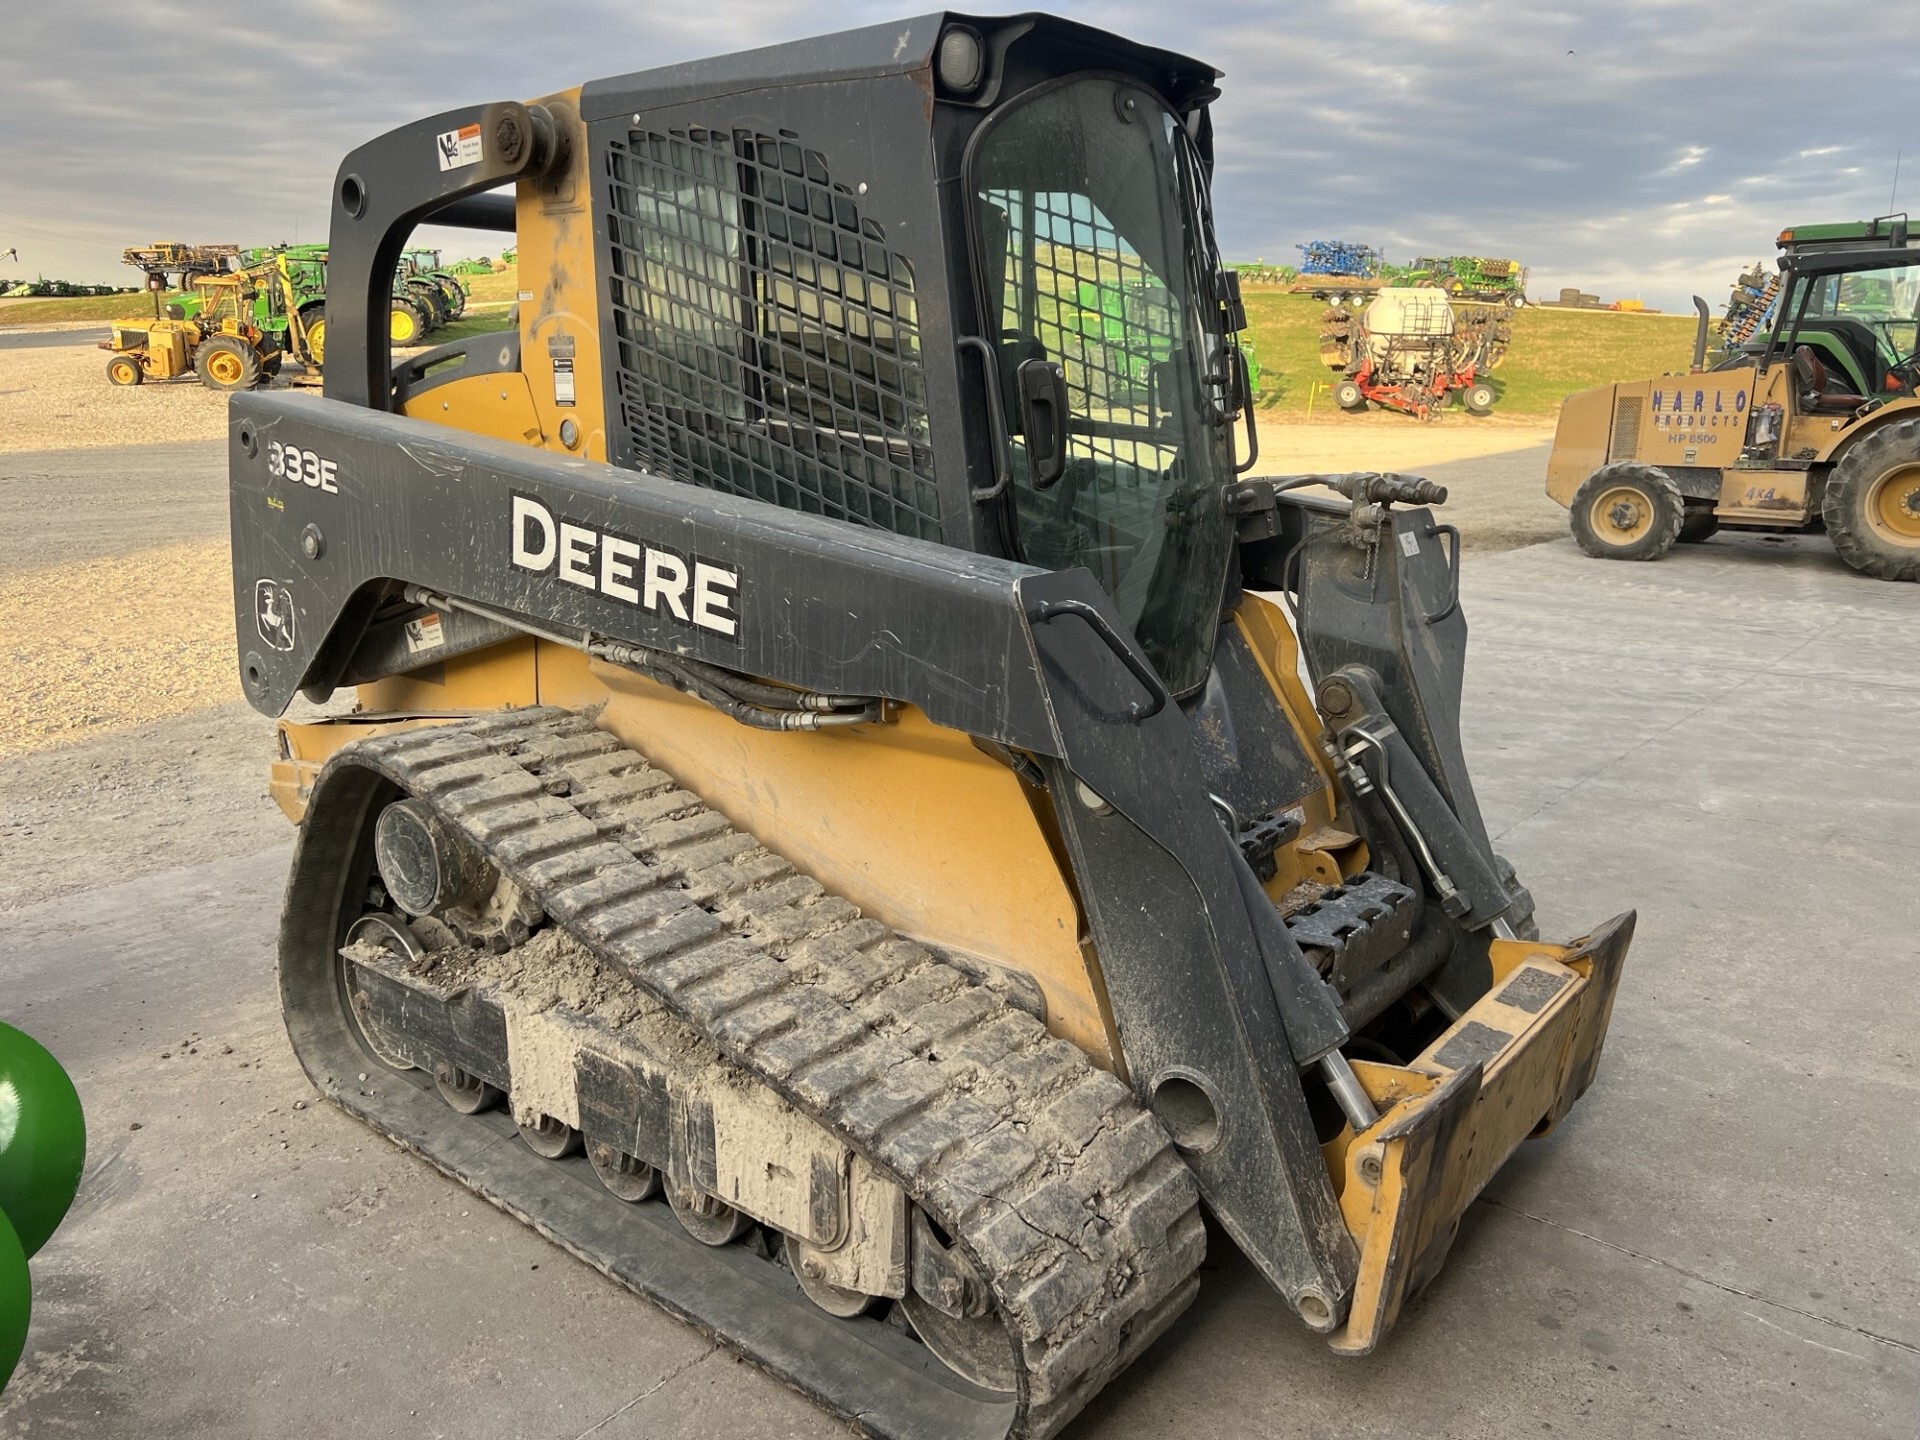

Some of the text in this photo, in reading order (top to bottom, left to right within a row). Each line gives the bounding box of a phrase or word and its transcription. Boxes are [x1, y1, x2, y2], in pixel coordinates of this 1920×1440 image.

[1652, 390, 1747, 413] HARLO
[1654, 415, 1739, 427] PRODUCTS
[1668, 434, 1718, 444] HP 8500
[268, 441, 338, 494] 333E
[512, 495, 738, 636] DEERE
